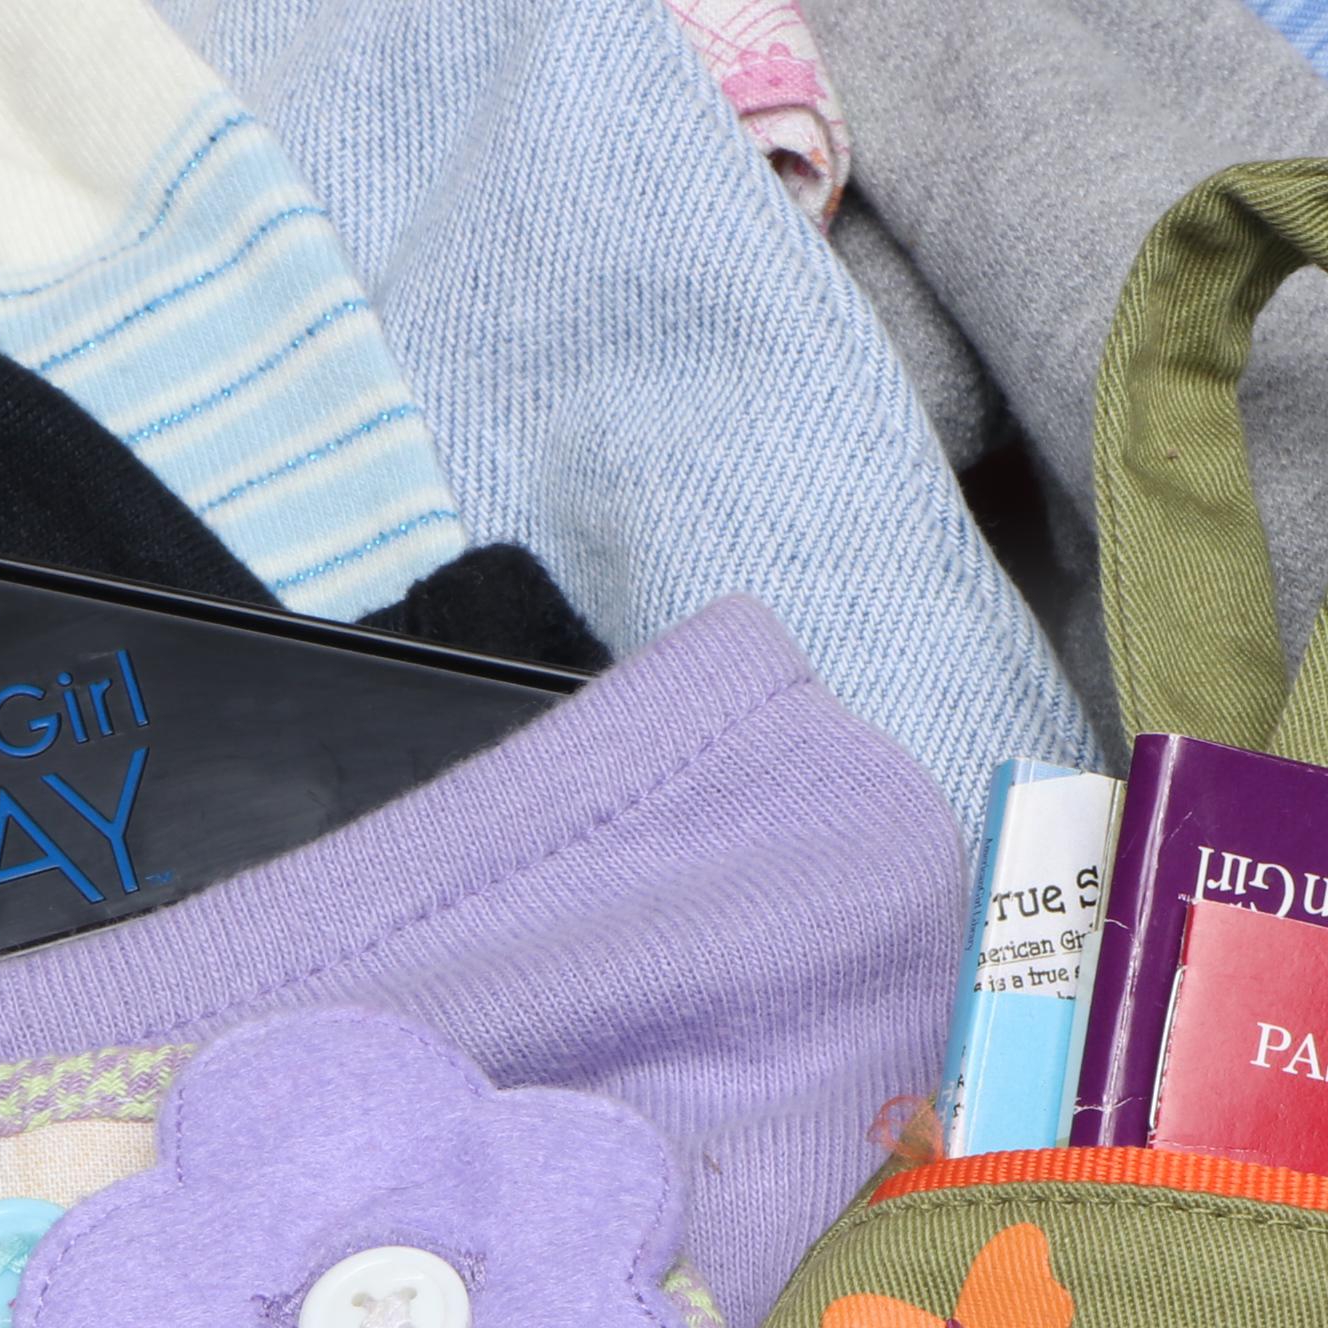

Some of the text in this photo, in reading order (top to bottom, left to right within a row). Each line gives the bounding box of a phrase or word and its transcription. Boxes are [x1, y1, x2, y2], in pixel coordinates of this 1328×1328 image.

[1197, 845, 1295, 920] Girl
[985, 884, 1067, 927] rue
[1028, 966, 1070, 987] true
